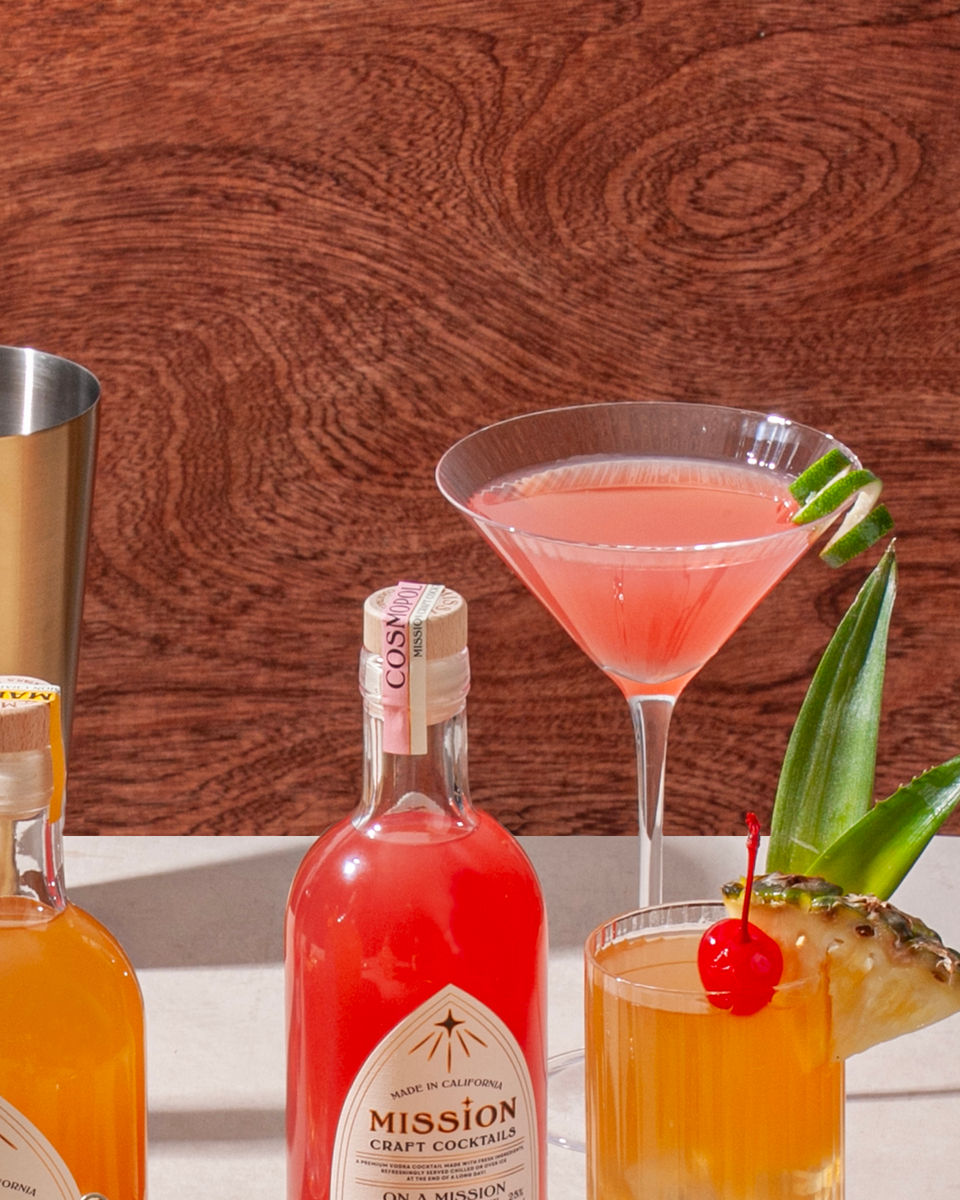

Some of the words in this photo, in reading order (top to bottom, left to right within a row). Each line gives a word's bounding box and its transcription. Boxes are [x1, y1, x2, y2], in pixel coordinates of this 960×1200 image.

[390, 1084, 424, 1100] MADE
[426, 1081, 438, 1090] IN
[442, 1078, 503, 1090] CALIFORNIA
[369, 1096, 517, 1135] MISSION
[370, 1139, 426, 1152] CRAFT
[432, 1127, 516, 1152] COCKTAILS
